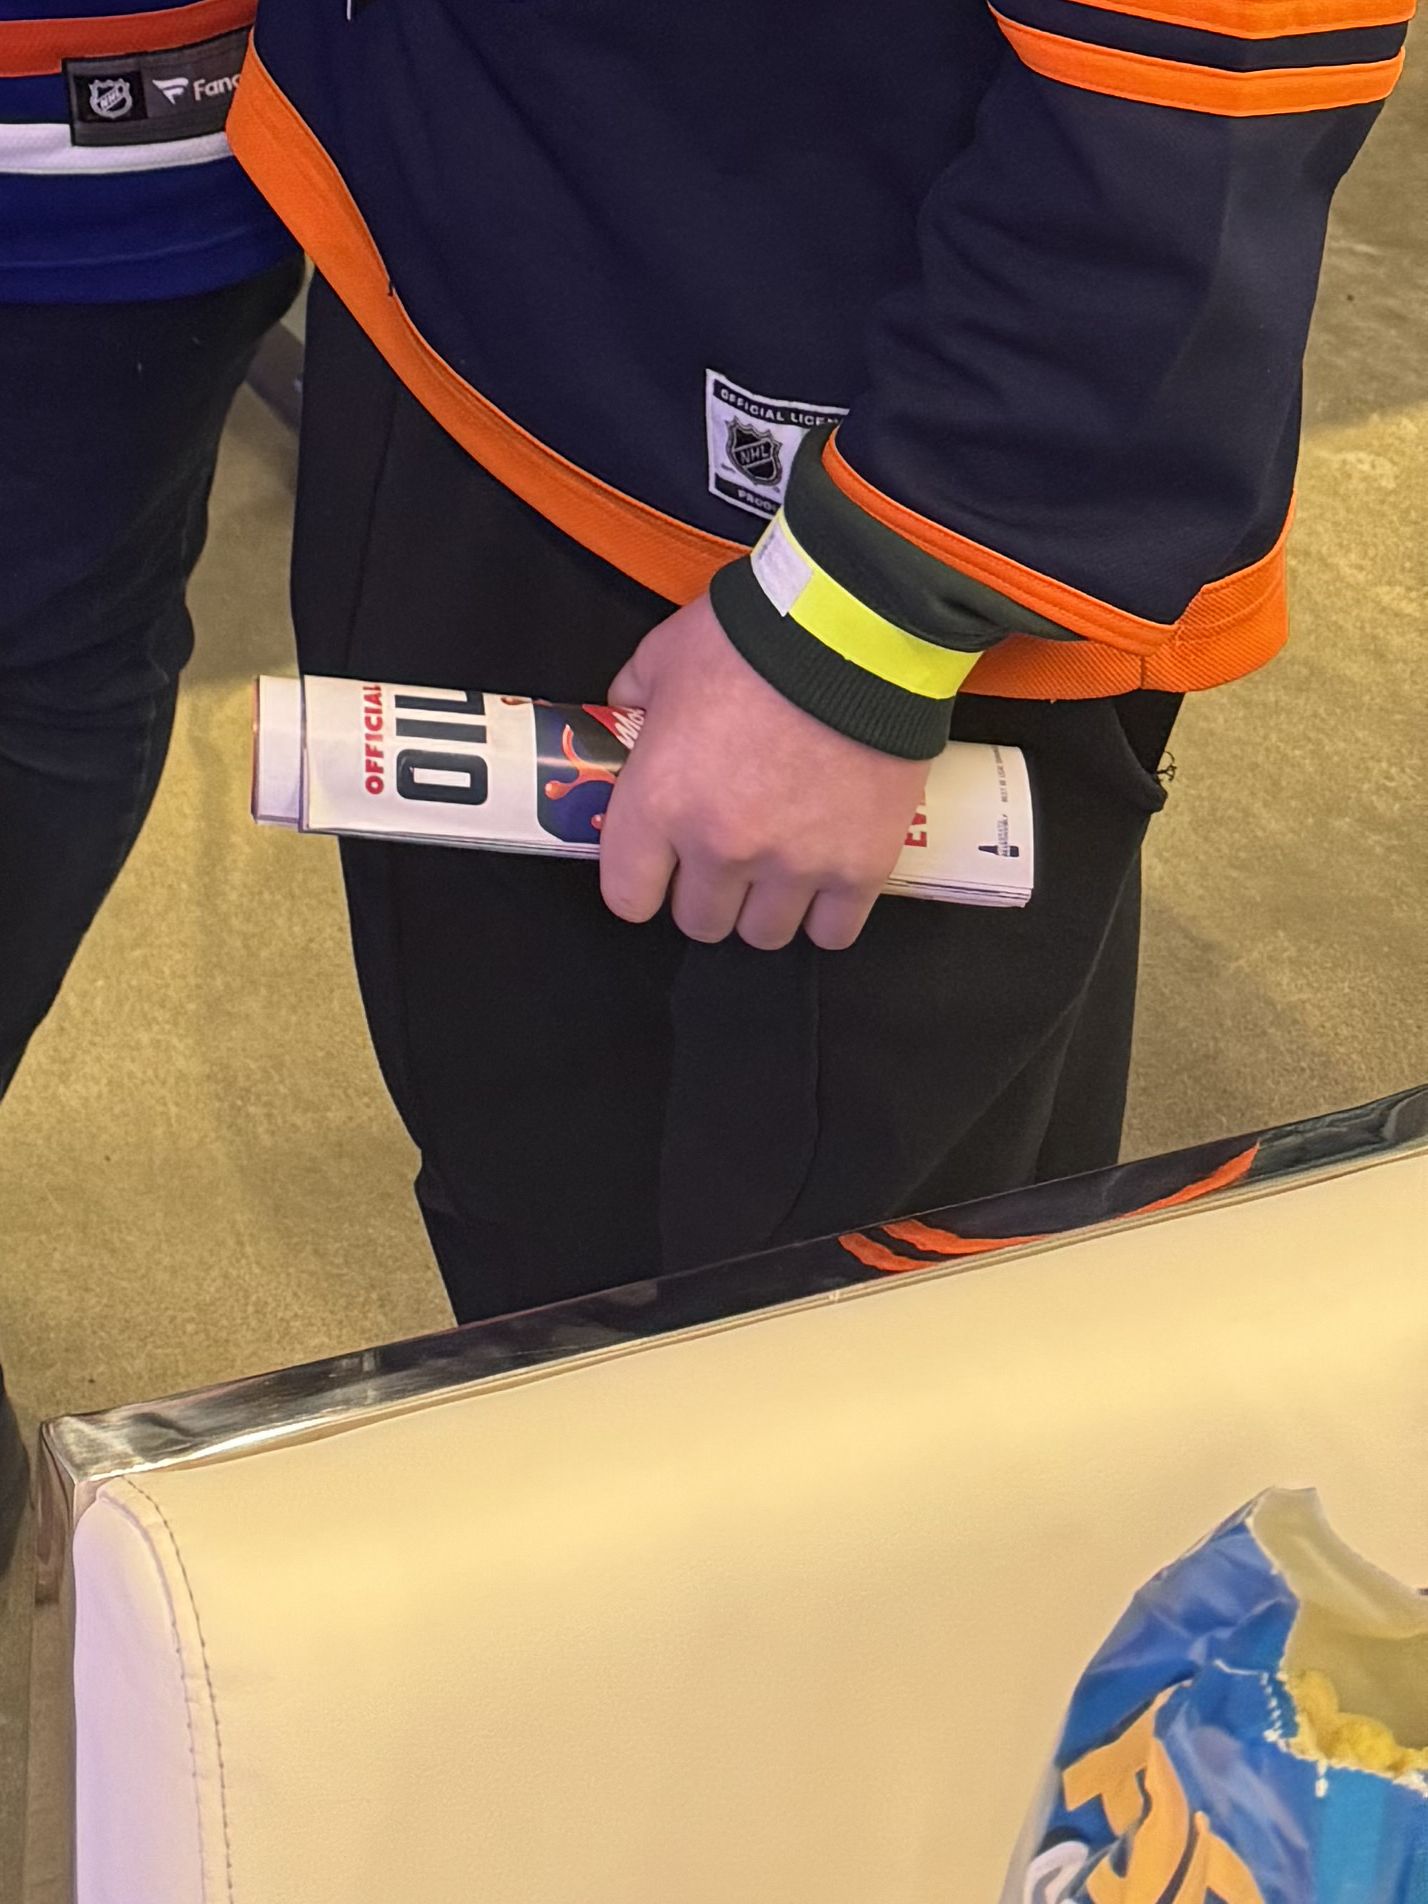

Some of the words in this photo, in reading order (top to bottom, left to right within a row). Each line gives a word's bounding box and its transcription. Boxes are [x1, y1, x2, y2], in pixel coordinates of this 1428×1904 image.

[720, 388, 785, 422] OFFICIAL
[739, 445, 769, 464] NHL
[362, 685, 385, 796] OFFICIAL
